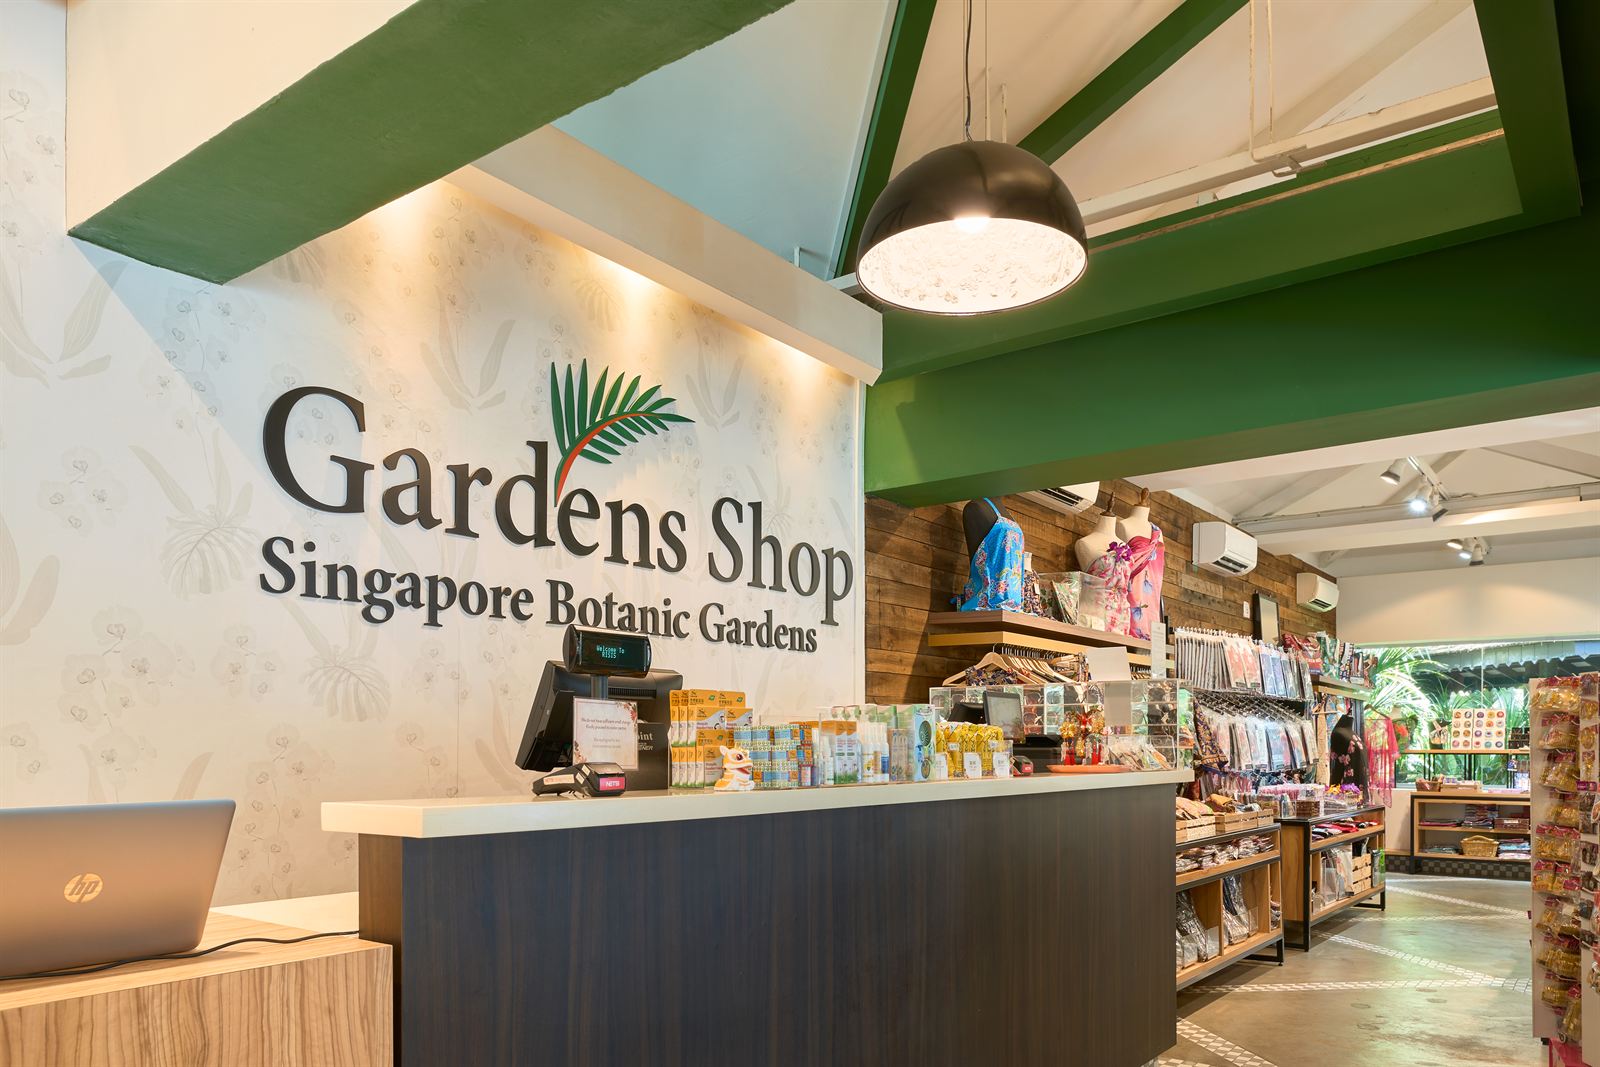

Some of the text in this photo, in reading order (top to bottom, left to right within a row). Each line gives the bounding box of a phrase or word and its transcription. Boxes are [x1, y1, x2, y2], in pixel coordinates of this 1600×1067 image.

[263, 386, 854, 627] Gardens Shop
[260, 537, 818, 653] Singapore Botanic Gardens
[596, 645, 617, 653] Welcome
[66, 873, 101, 903] hp
